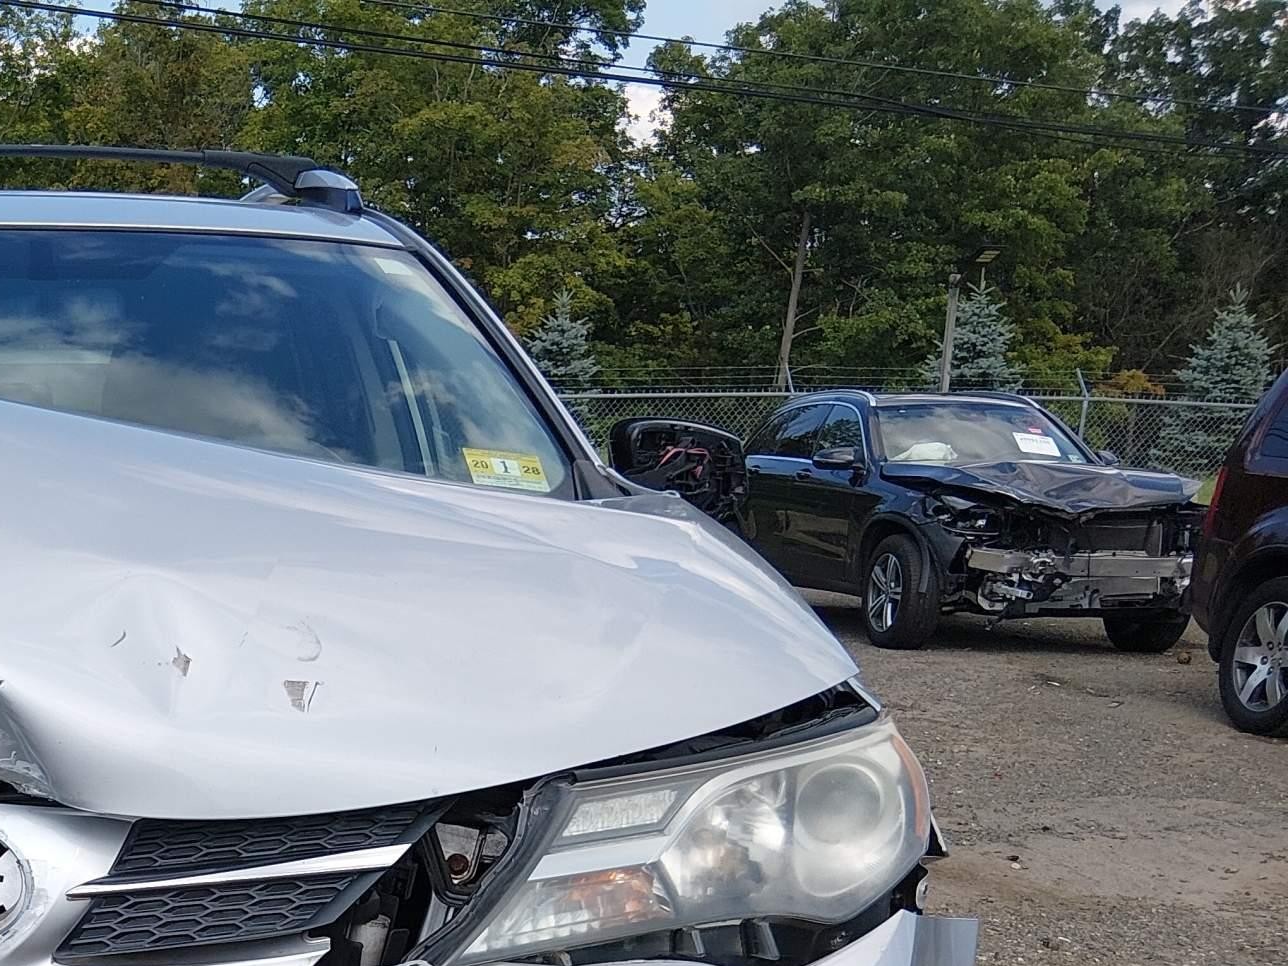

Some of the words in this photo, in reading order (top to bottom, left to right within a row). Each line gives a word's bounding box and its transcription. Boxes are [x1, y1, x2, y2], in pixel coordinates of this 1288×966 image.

[472, 459, 489, 470] 20
[499, 460, 511, 474] 1
[522, 465, 541, 476] 28
